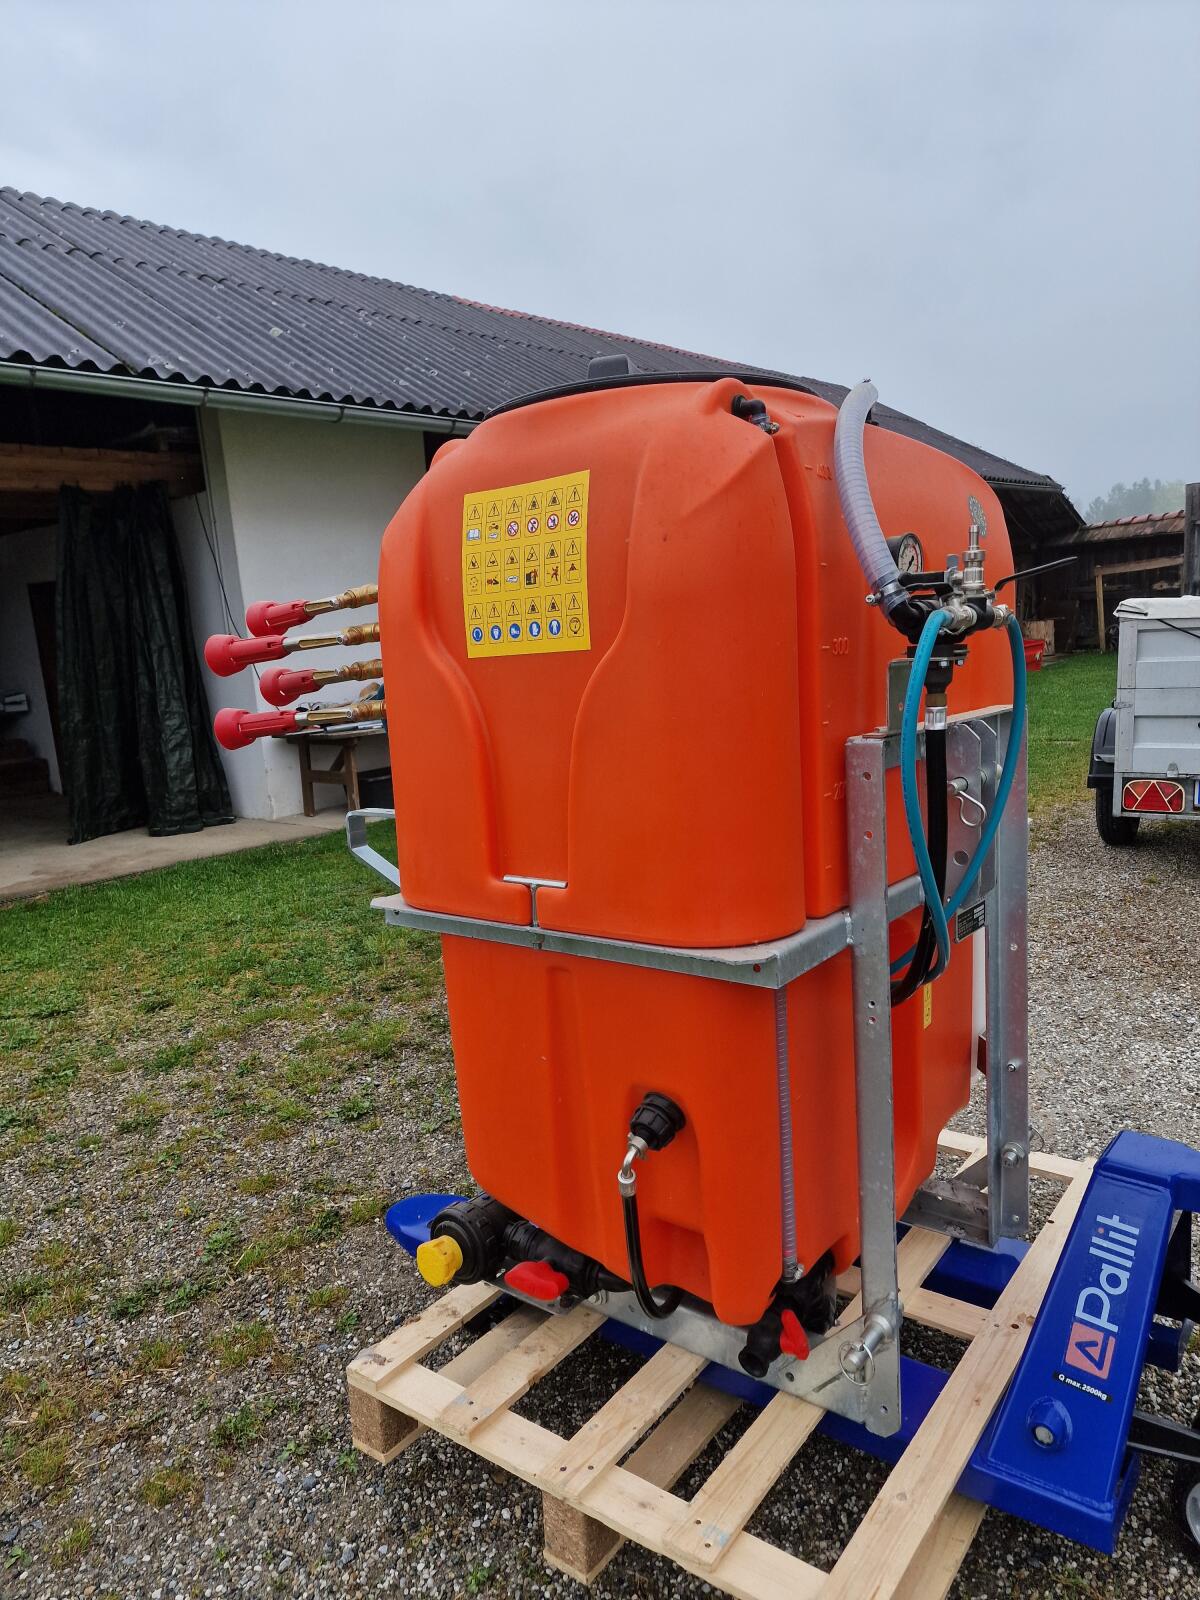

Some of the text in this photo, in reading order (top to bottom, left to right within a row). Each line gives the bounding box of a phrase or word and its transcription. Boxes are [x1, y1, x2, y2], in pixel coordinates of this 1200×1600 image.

[832, 637, 848, 655] 300
[1074, 1214, 1140, 1333] Pallit
[1058, 1373, 1065, 1382] Q
